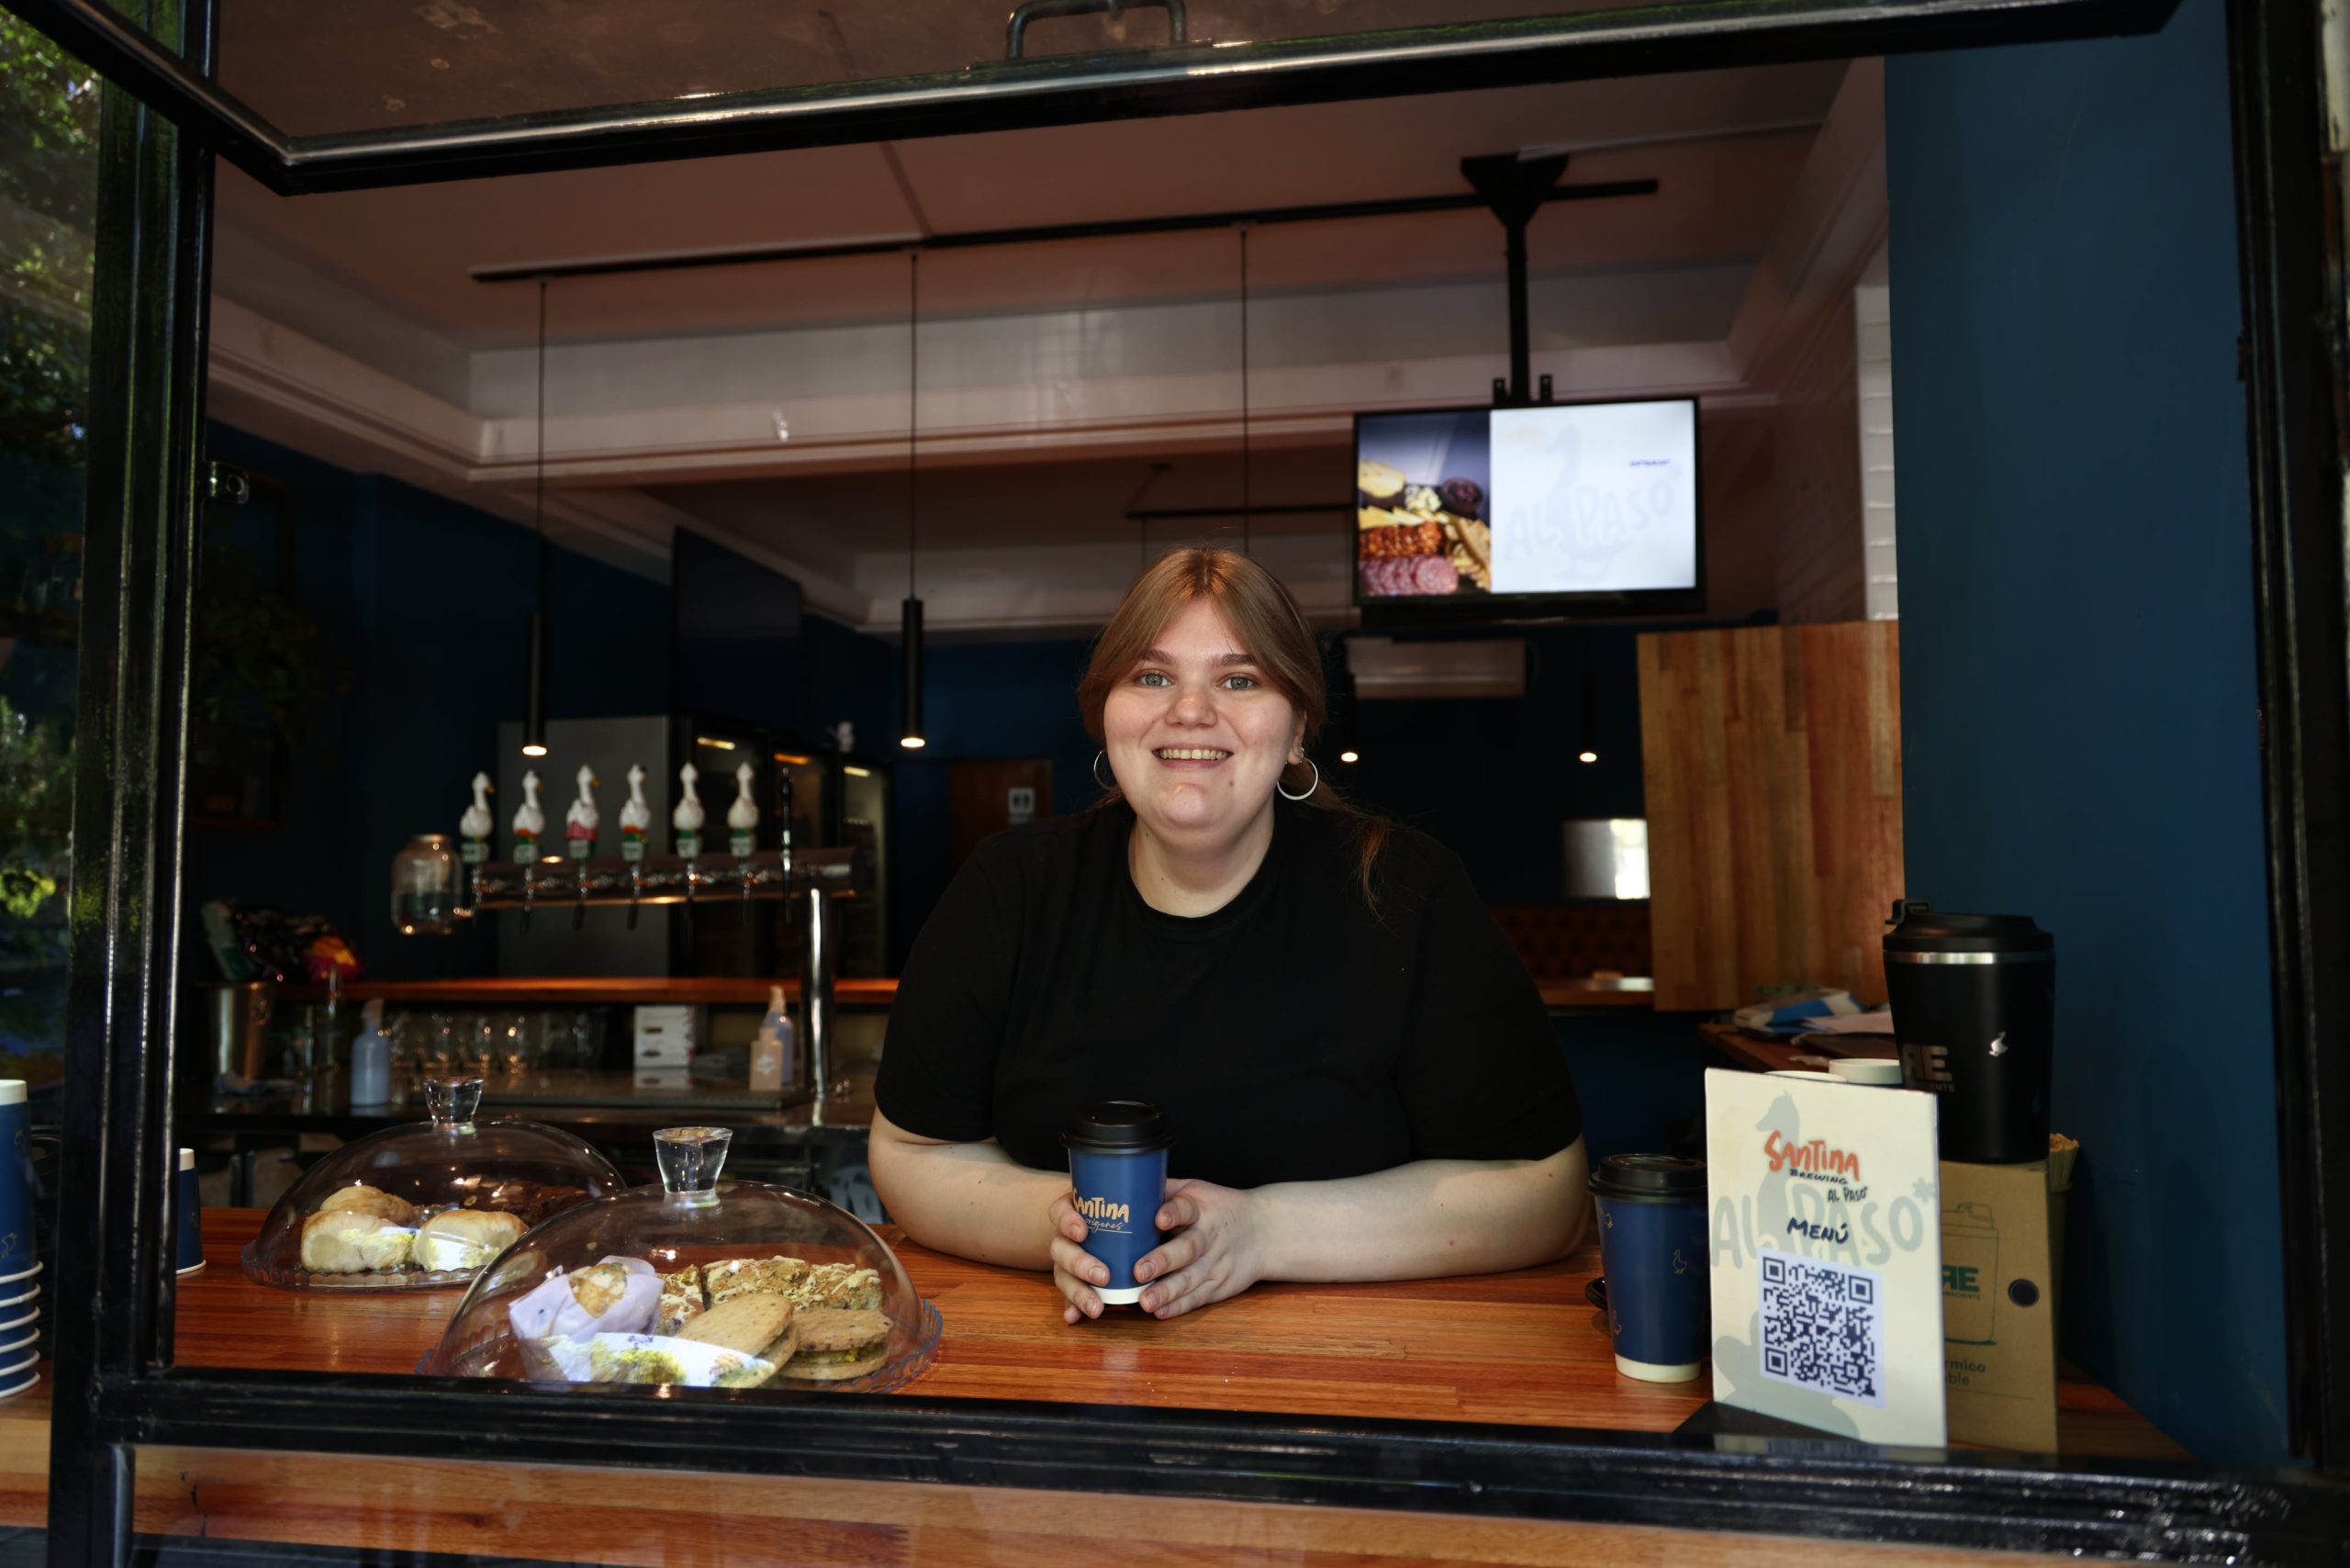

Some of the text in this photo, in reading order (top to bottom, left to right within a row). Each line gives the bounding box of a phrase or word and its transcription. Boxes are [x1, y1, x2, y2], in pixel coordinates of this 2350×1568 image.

[1789, 1168, 1848, 1185] BREWING
[1828, 1189, 1840, 1203] AL
[1086, 1217, 1125, 1234] rigenes
[1787, 1216, 1849, 1244] MENÚ
[1944, 1358, 1986, 1373] rmico
